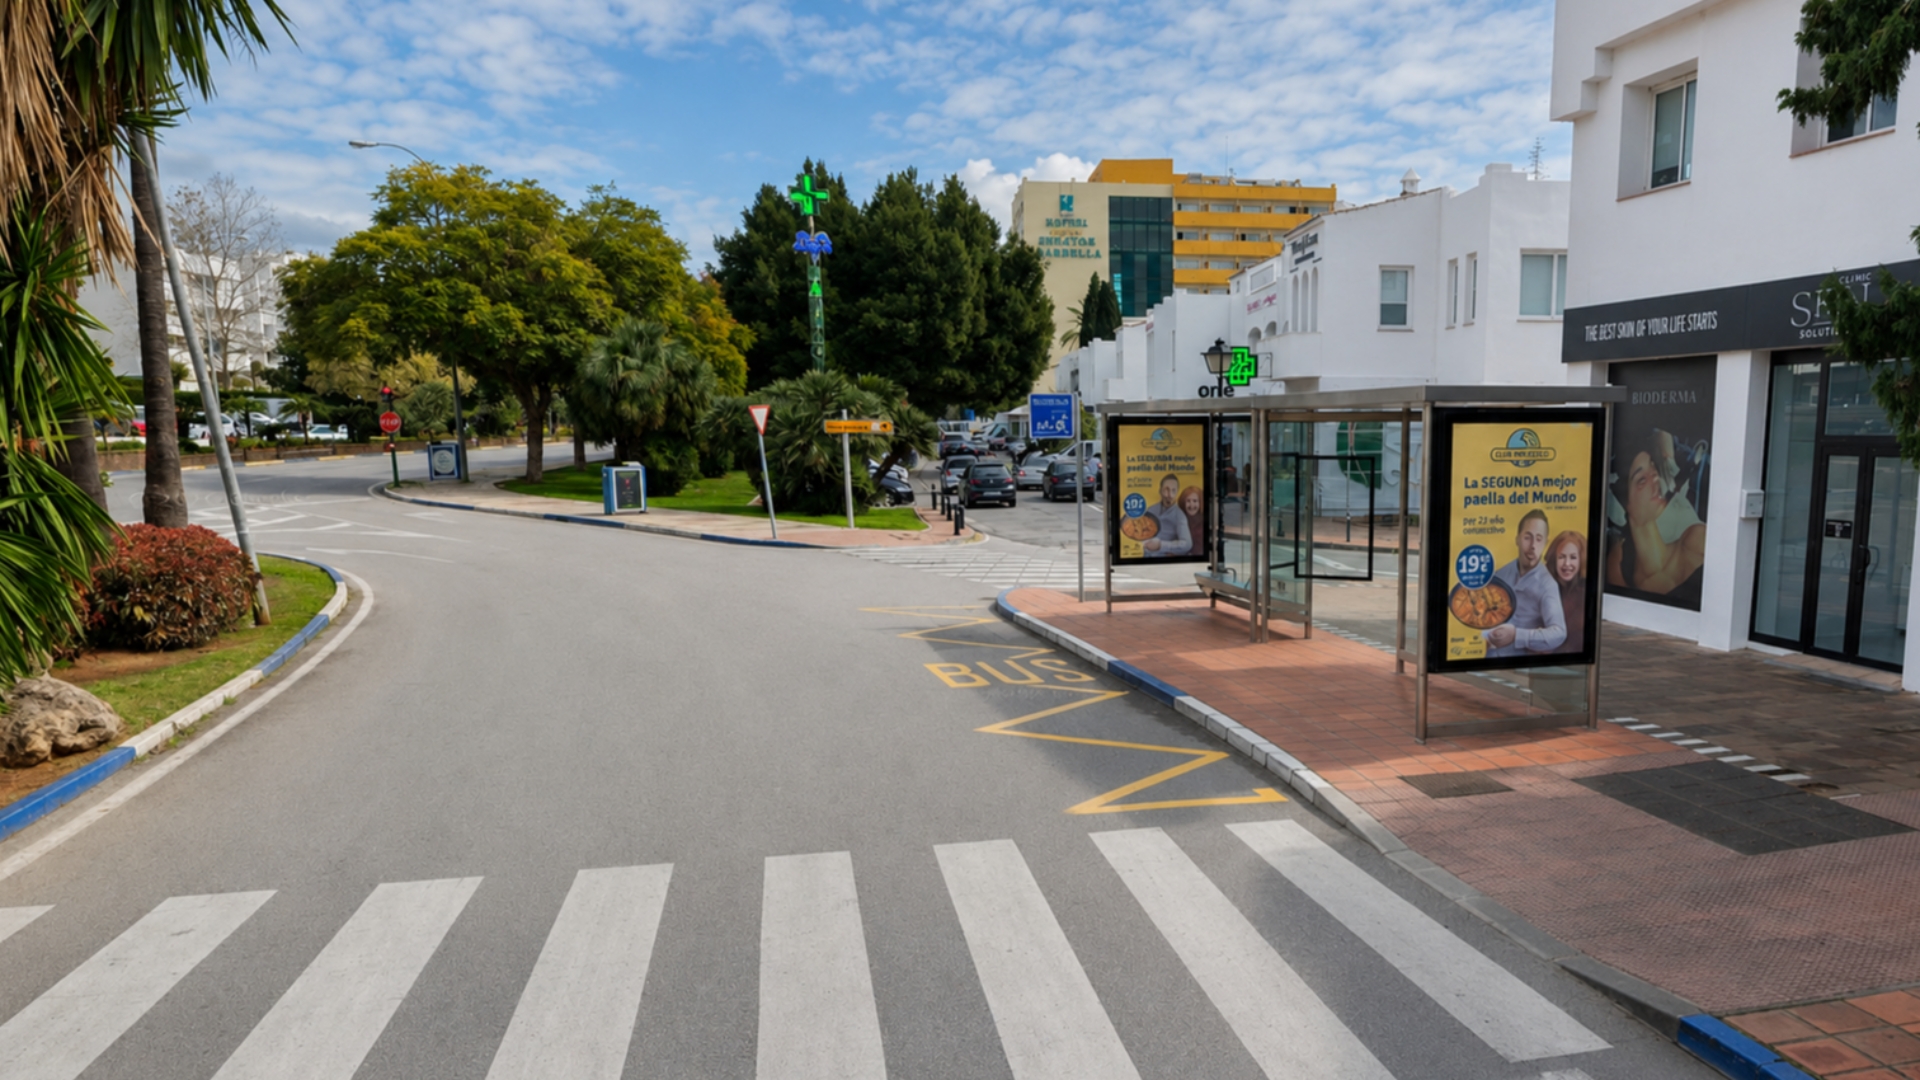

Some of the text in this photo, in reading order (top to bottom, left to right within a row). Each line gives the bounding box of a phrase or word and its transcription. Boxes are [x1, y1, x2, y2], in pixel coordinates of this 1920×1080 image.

[1585, 310, 1718, 342] THE BEST SKIN OF YOUR LIFE STARTS
[1632, 390, 1697, 404] BIODERMA
[1464, 474, 1577, 490] La SEGUNDA mejor
[1464, 490, 1577, 509] paella del Mundo
[923, 658, 1096, 688] BUS
